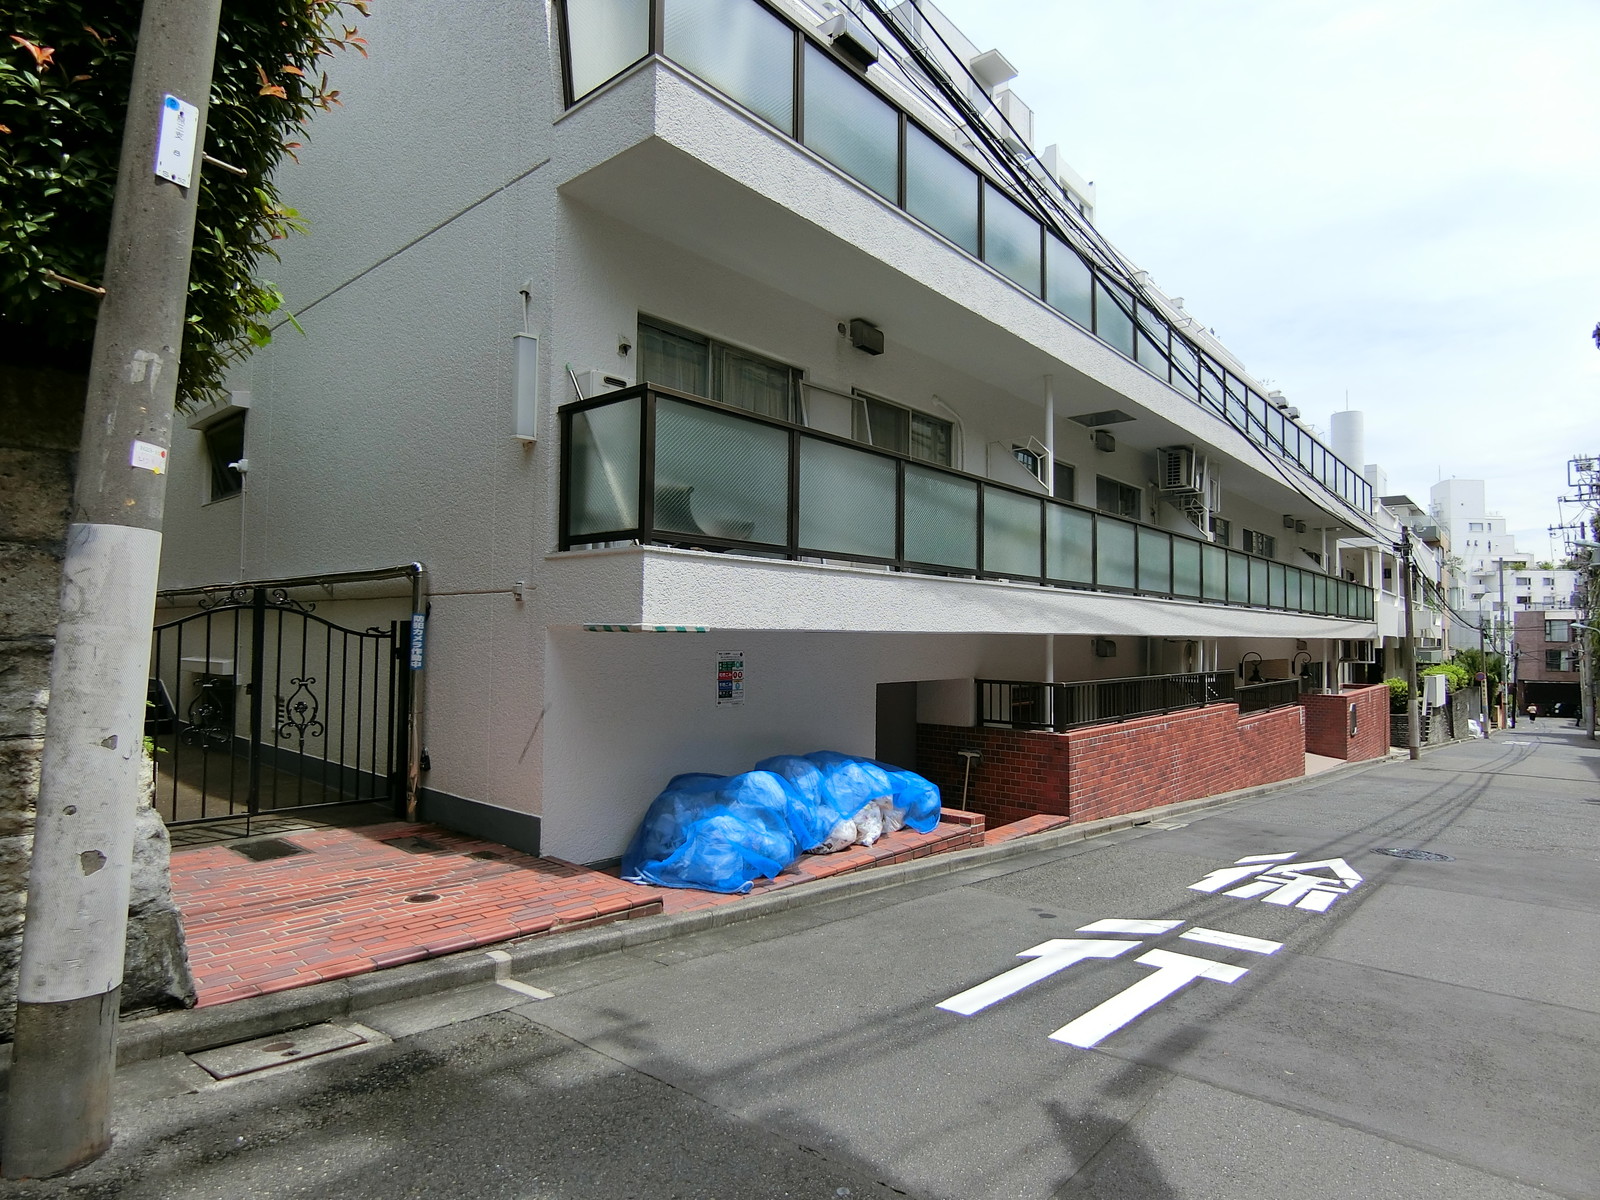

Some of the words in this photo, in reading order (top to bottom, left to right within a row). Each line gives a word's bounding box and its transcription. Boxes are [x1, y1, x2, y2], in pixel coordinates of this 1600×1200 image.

[410, 615, 425, 668] 防犯カメラ作動中
[935, 851, 1364, 1049] 徐行
